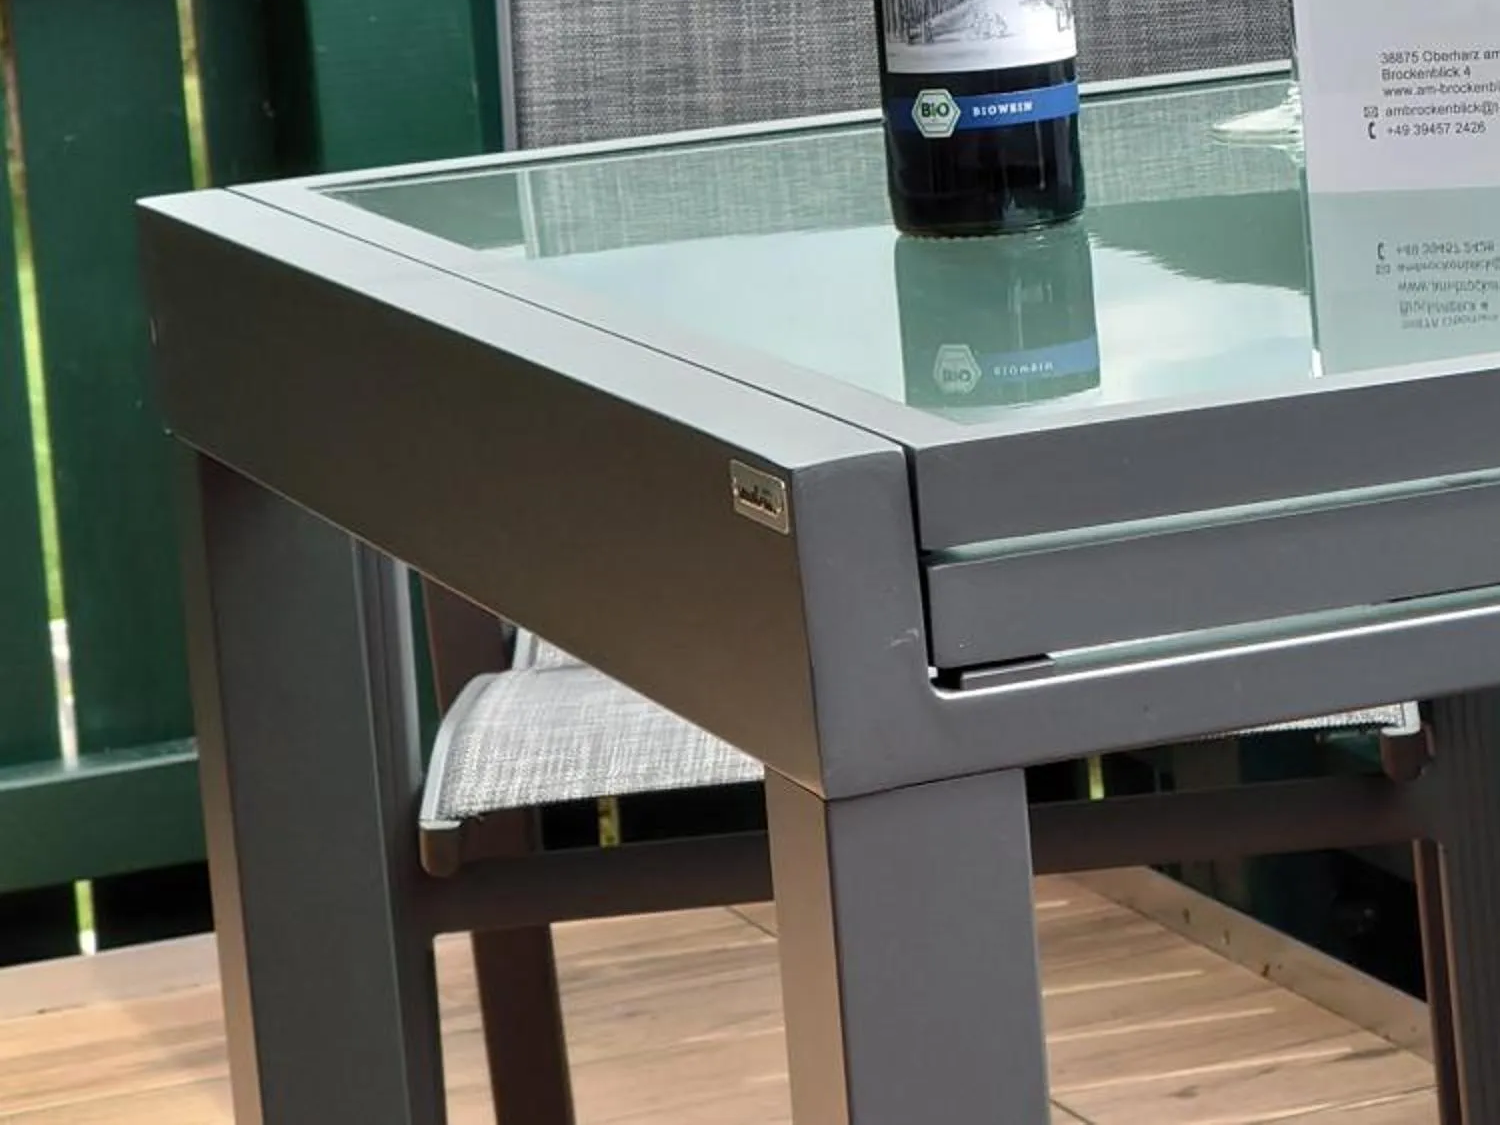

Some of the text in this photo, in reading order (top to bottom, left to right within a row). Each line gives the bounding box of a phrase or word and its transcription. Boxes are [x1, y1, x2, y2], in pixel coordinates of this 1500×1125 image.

[1422, 49, 1480, 62] Oberharz
[1381, 67, 1460, 80] Brockenblick
[972, 101, 1033, 117] BIOWEIN
[1413, 122, 1452, 135] 39457
